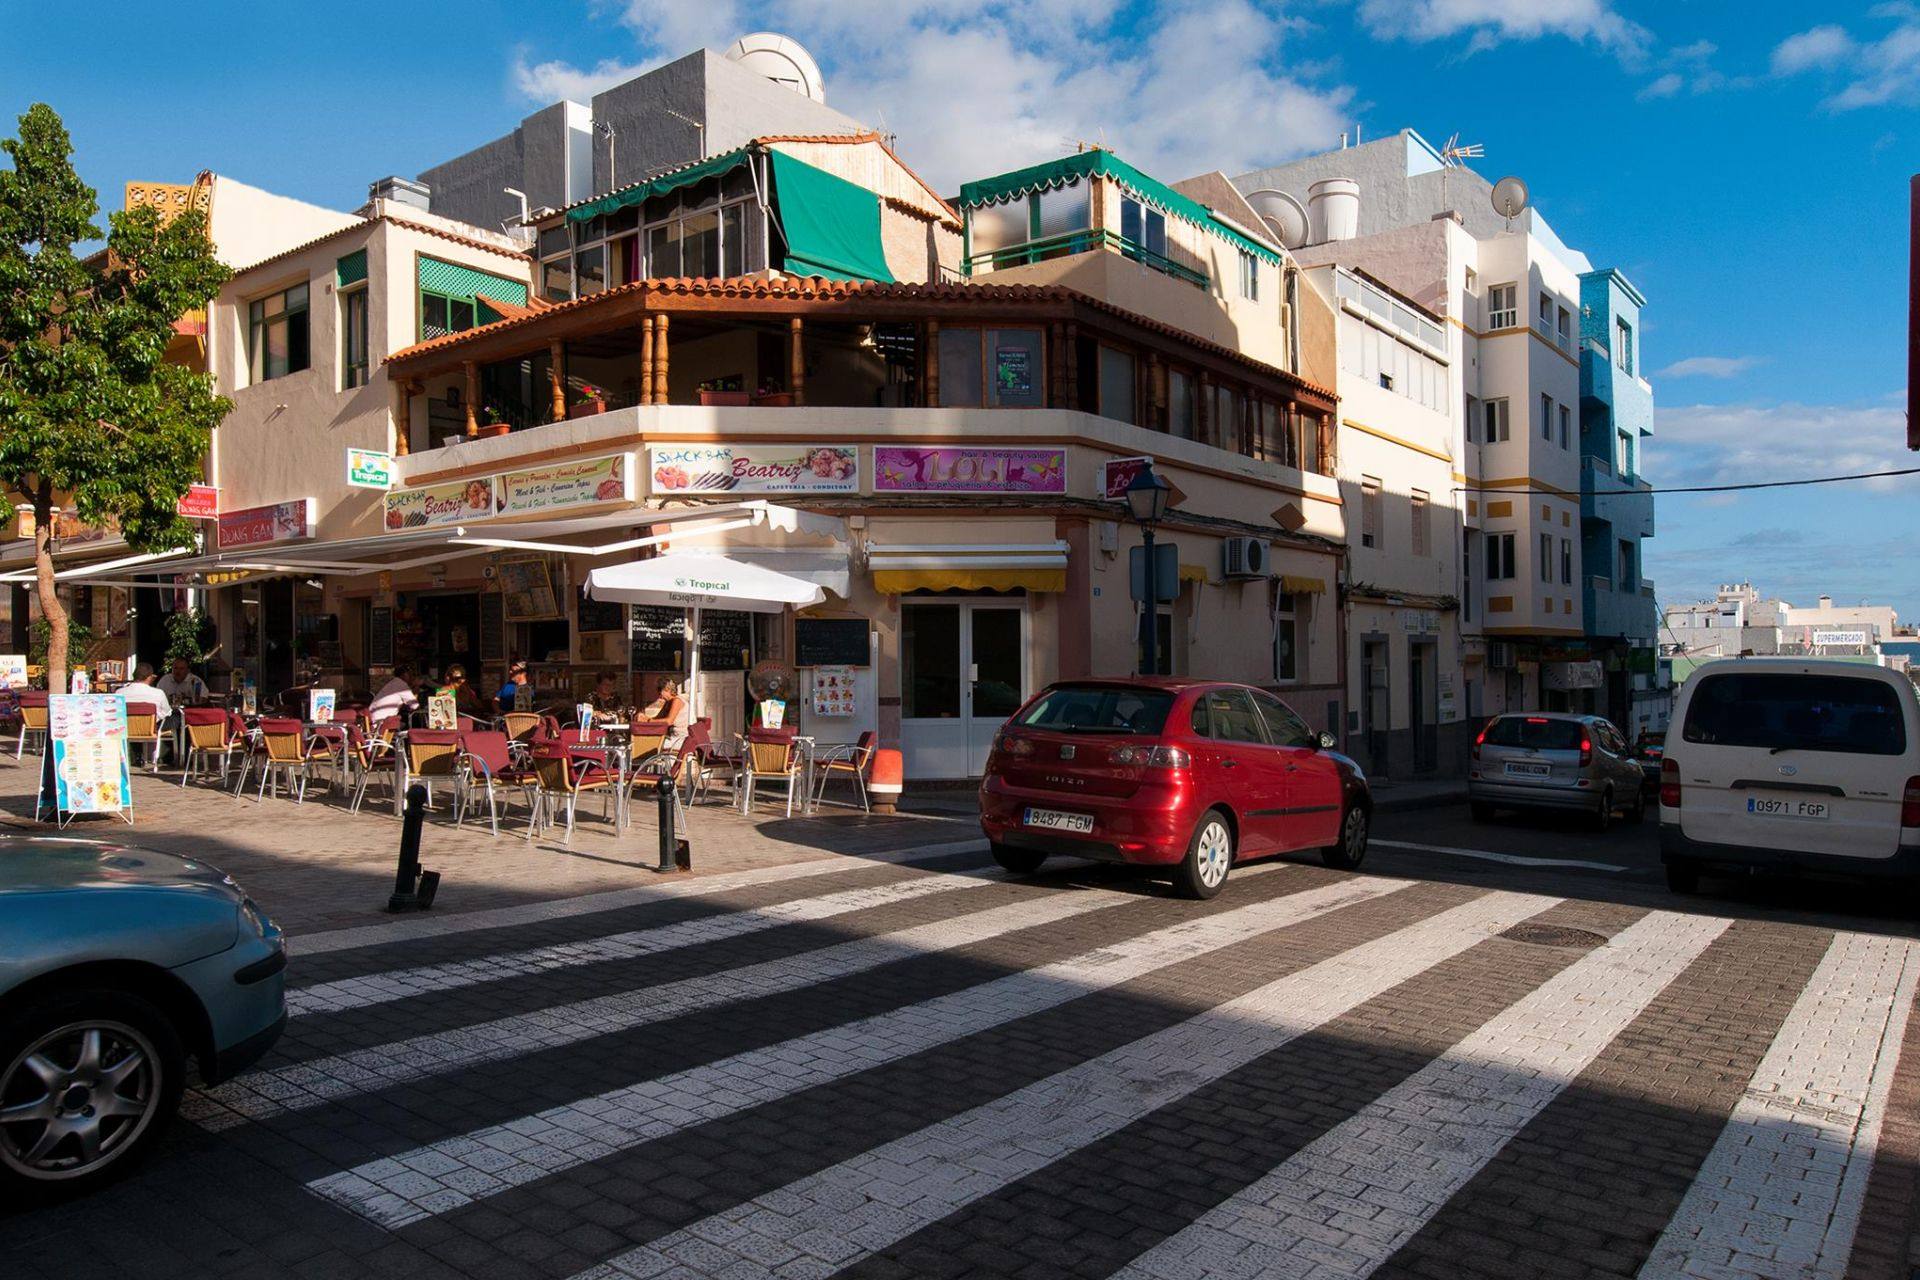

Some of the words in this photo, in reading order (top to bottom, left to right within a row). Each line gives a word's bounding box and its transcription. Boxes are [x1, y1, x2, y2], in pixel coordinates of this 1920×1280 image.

[707, 449, 733, 461] BAR
[731, 457, 805, 484] Beatriz
[929, 454, 1003, 482] LOLI
[354, 471, 388, 483] Tropical
[424, 495, 464, 517] Beatriz
[221, 526, 248, 544] DUNG
[252, 523, 274, 540] GAN
[689, 579, 730, 590] Tropical
[633, 641, 662, 650] PIZZA
[1817, 633, 1863, 644] SUPERMERCADO
[1756, 800, 1788, 813] 0971
[1798, 803, 1824, 816] FGP
[1032, 811, 1062, 826] 8487
[1067, 814, 1092, 831] FGM
